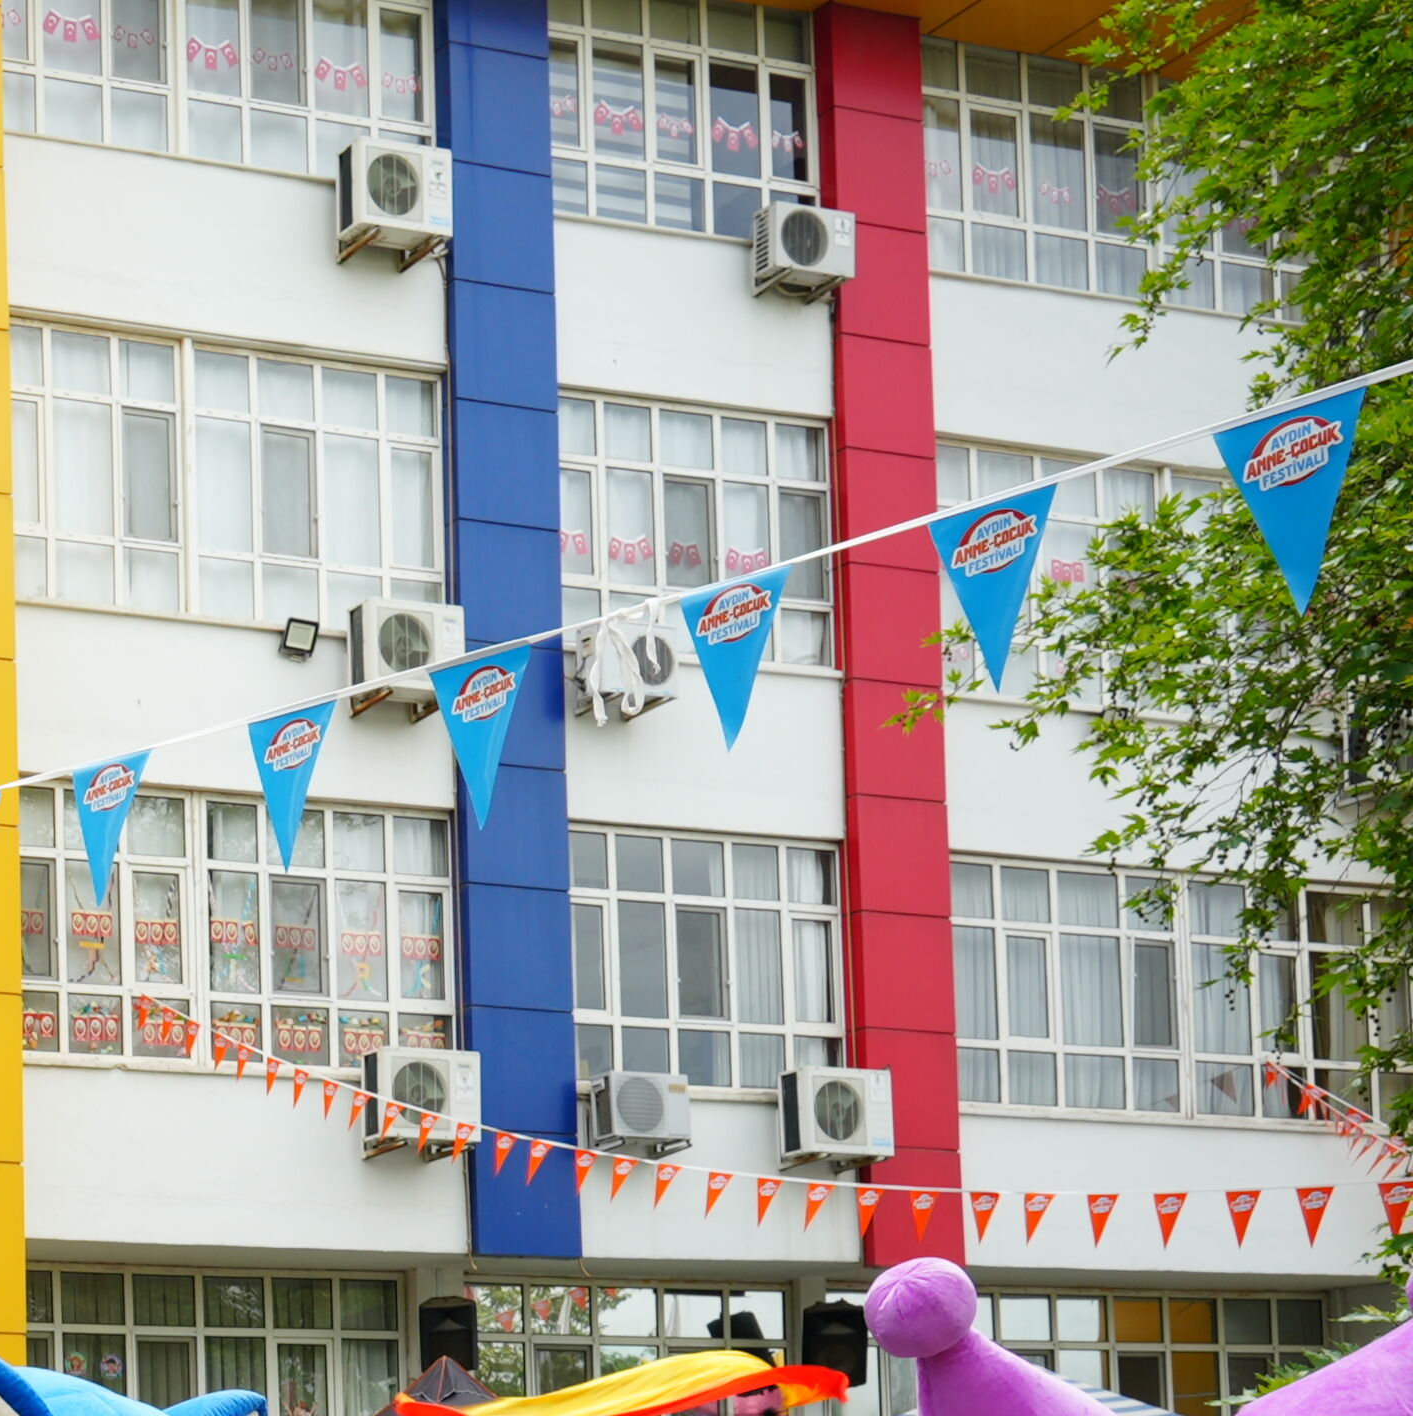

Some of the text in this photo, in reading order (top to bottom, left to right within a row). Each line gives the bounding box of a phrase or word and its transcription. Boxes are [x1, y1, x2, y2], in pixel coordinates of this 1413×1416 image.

[1246, 424, 1341, 480] ANNE-ÇOCUK
[1271, 423, 1312, 451] AYDIN
[1262, 452, 1325, 489] FESTİVALİ
[954, 519, 1035, 566] ANNE-ÇOCUK
[976, 515, 1012, 541] AYDIN
[968, 539, 1022, 574] FESTİVALİ
[699, 593, 770, 634] ANNE-ÇOCUK
[718, 589, 750, 611] AYDIN
[710, 611, 758, 642] FESTİVALİ
[454, 675, 514, 713] ANNE-ÇOCUK
[471, 671, 498, 692] AYDIN
[464, 696, 505, 721] FESTİVALİ
